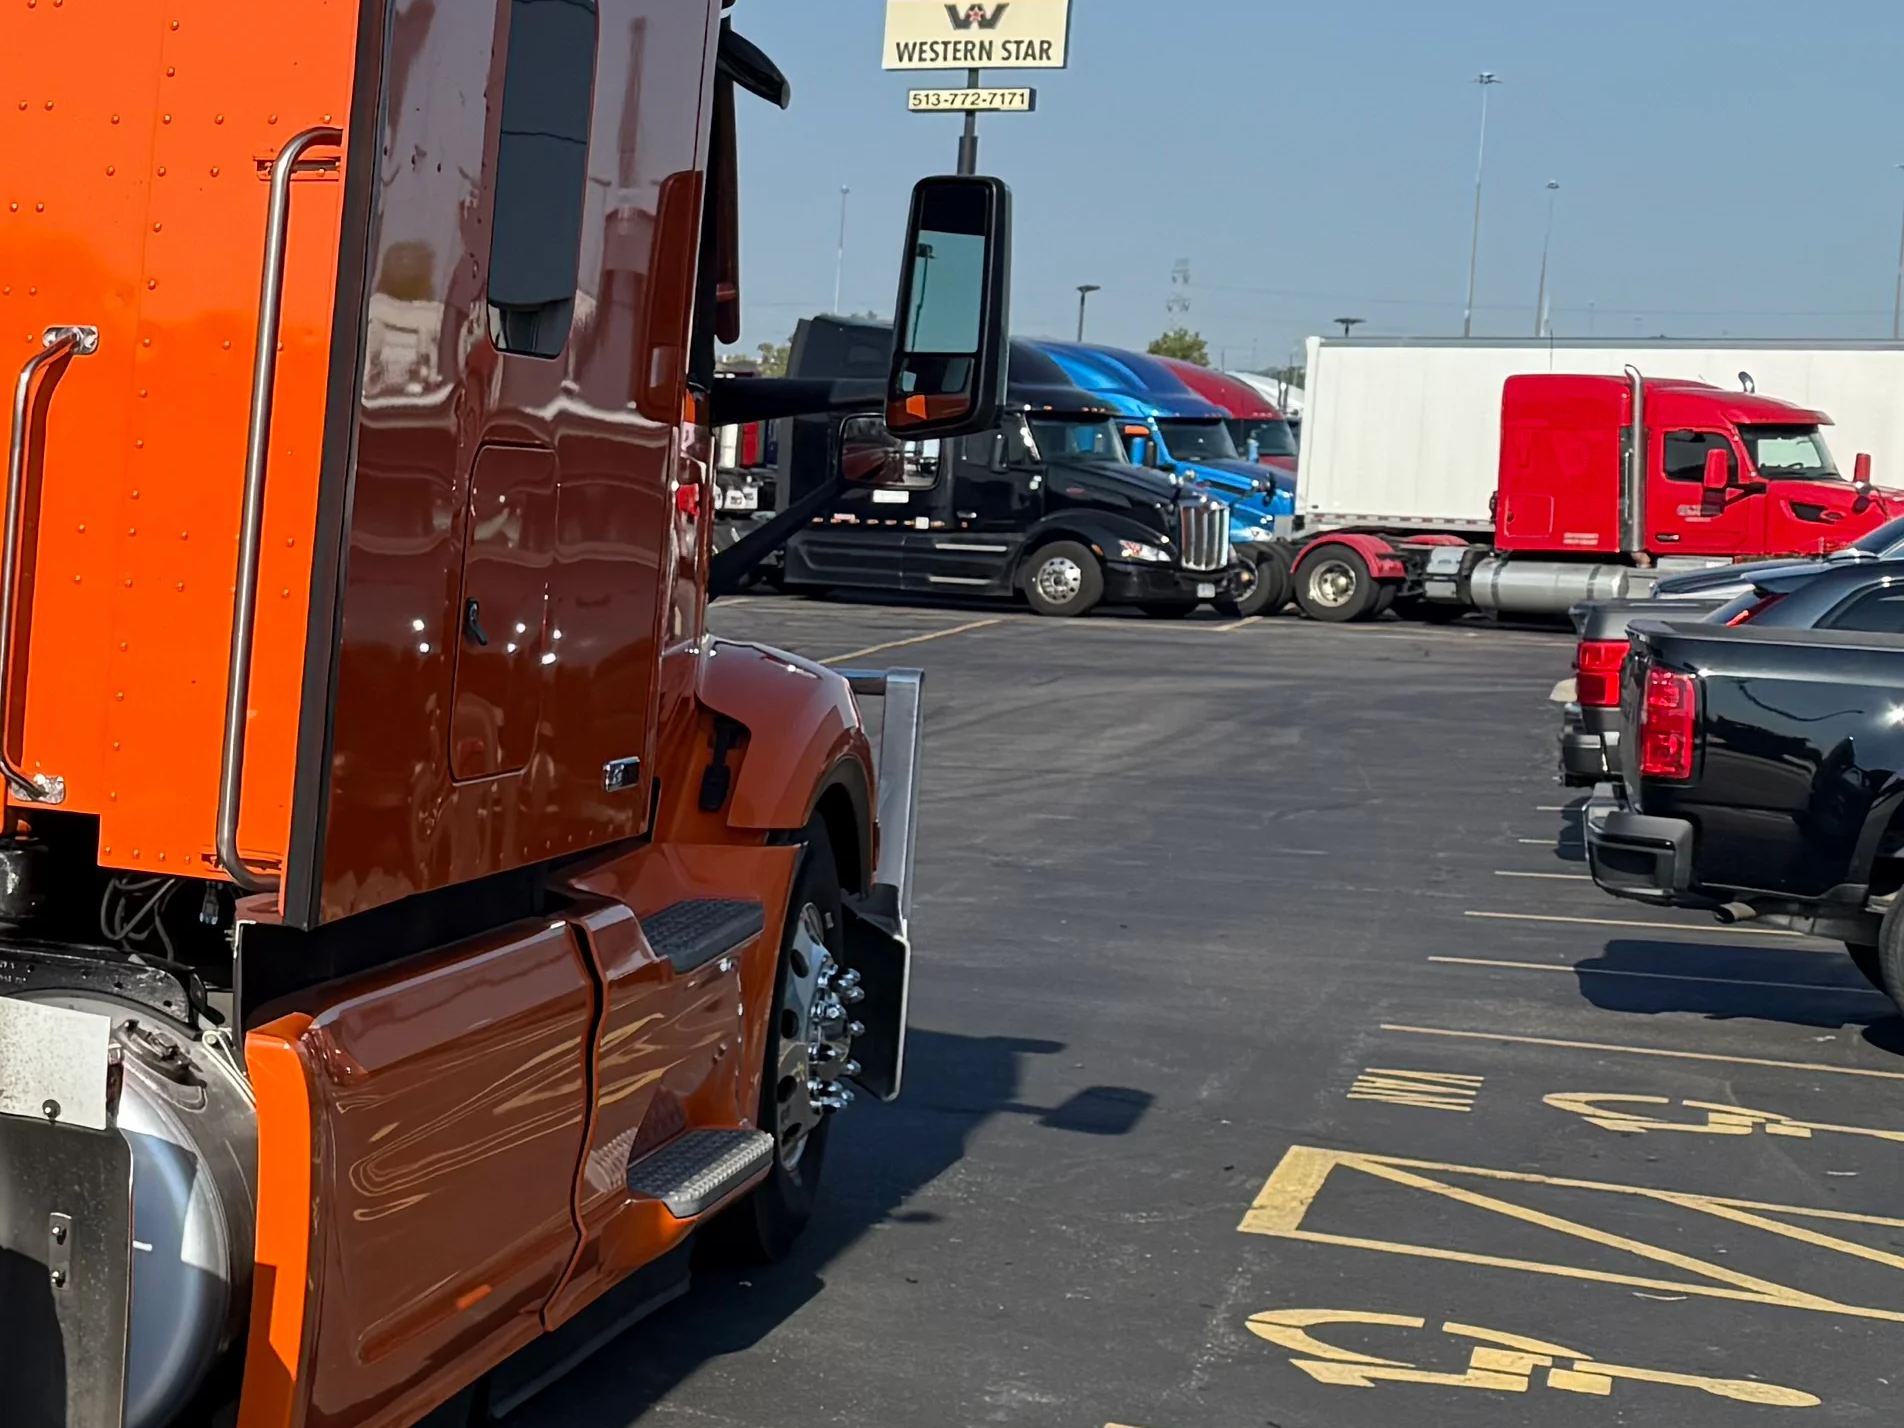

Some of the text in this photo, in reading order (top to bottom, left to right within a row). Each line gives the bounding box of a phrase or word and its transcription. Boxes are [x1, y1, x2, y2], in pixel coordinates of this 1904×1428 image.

[896, 40, 1053, 62] WESTERN STAR
[912, 92, 1026, 107] 513-772-7171
